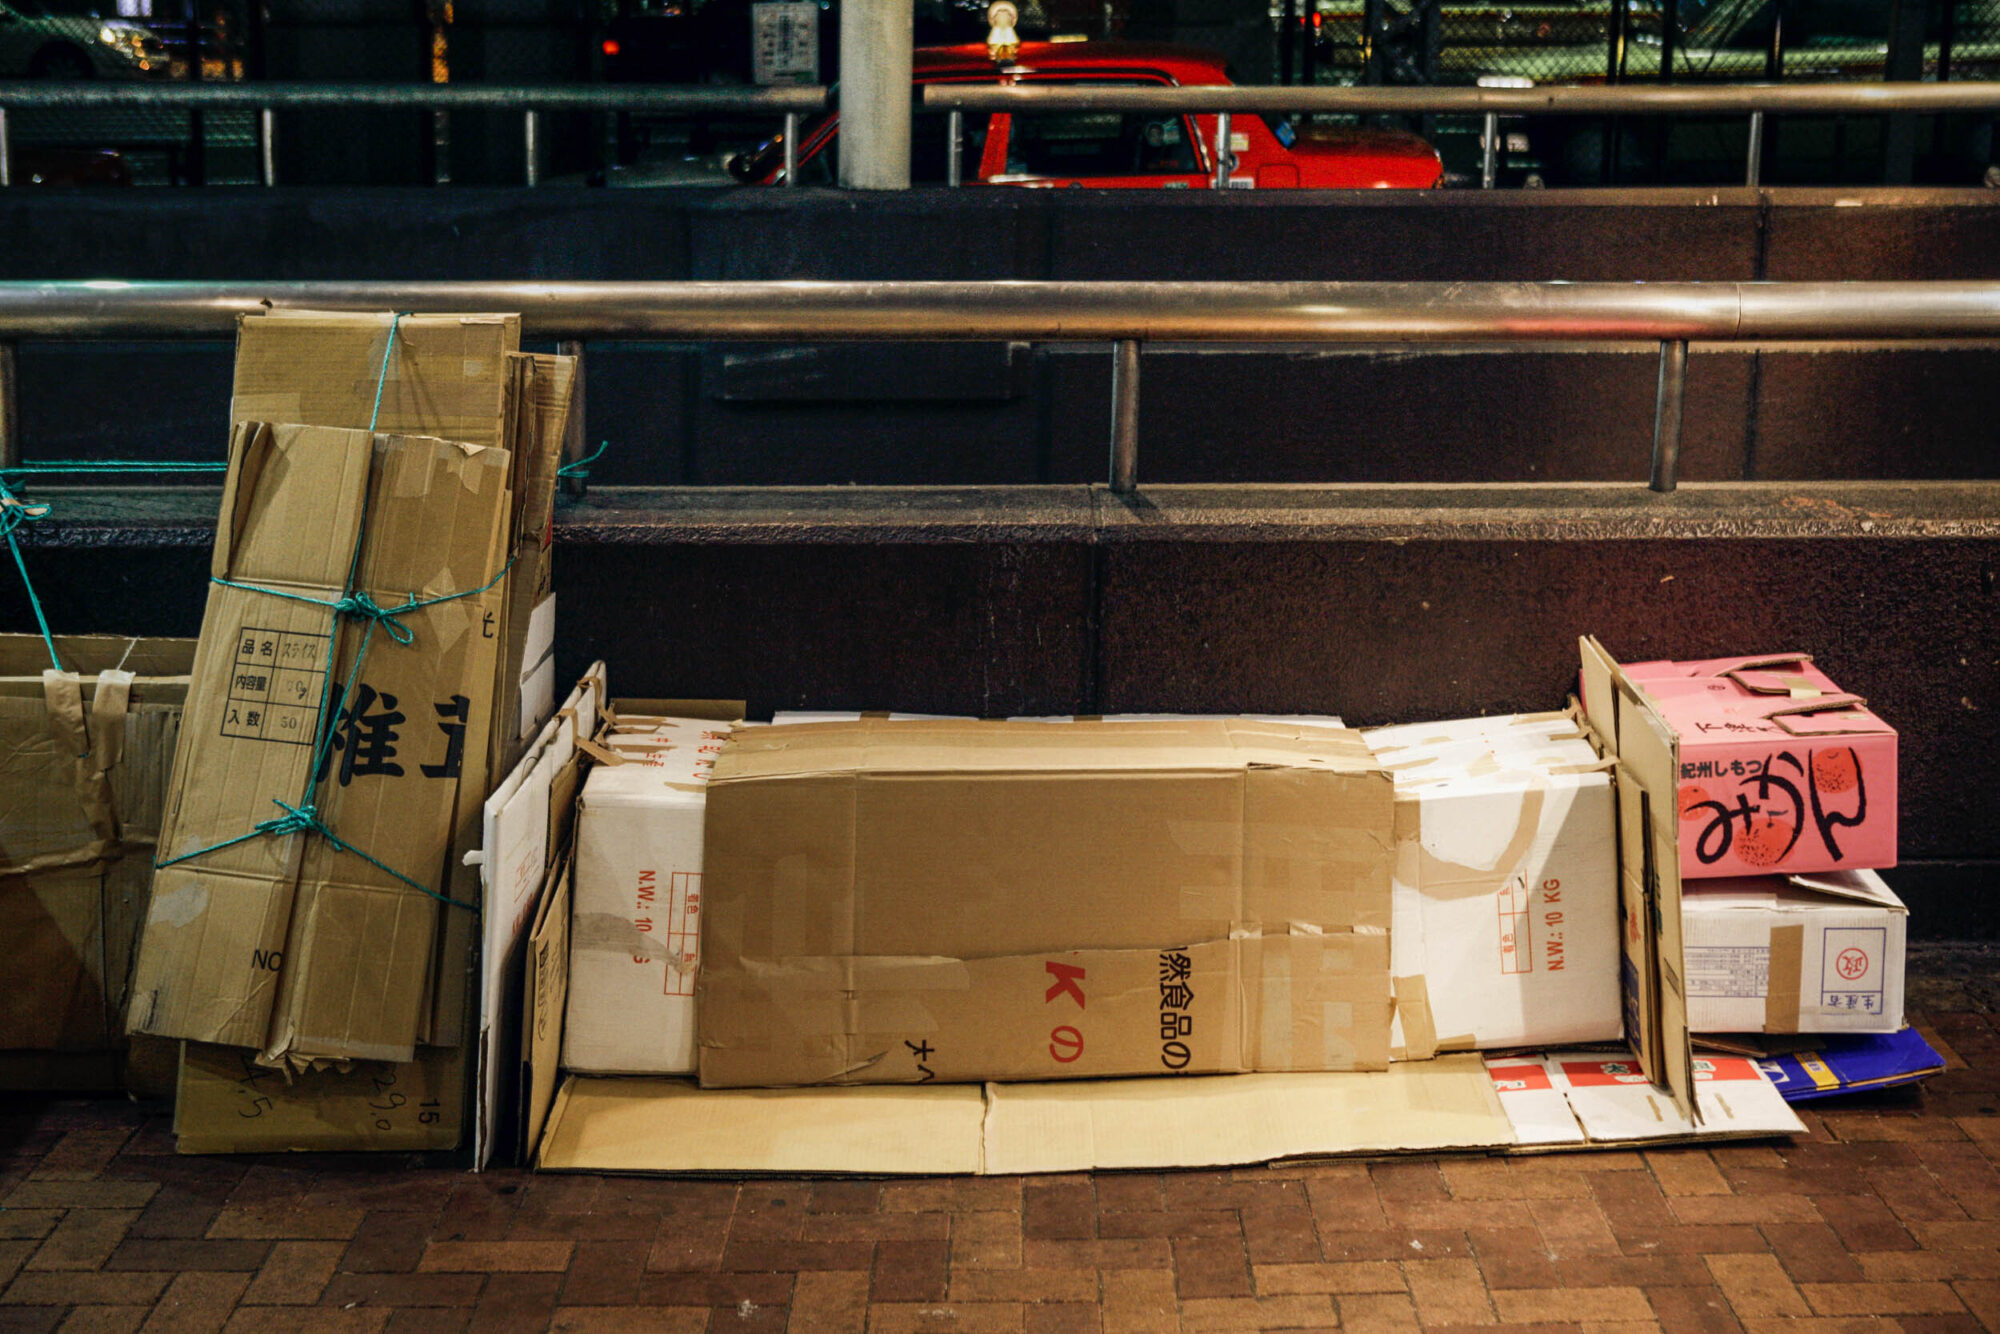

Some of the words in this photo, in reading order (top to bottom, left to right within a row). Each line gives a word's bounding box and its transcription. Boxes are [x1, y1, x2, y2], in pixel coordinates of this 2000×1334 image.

[241, 638, 273, 657] 品名
[234, 674, 267, 692] 内容量
[227, 708, 261, 727] 入数
[280, 716, 297, 730] 50
[1680, 758, 1763, 780] 紀州しもつ
[1684, 746, 1867, 864] みかん
[1543, 878, 1562, 904] KG
[634, 917, 653, 932] 10
[1544, 911, 1565, 928] 10
[1159, 947, 1195, 1074] 然食品の
[418, 1097, 441, 1125] 15
